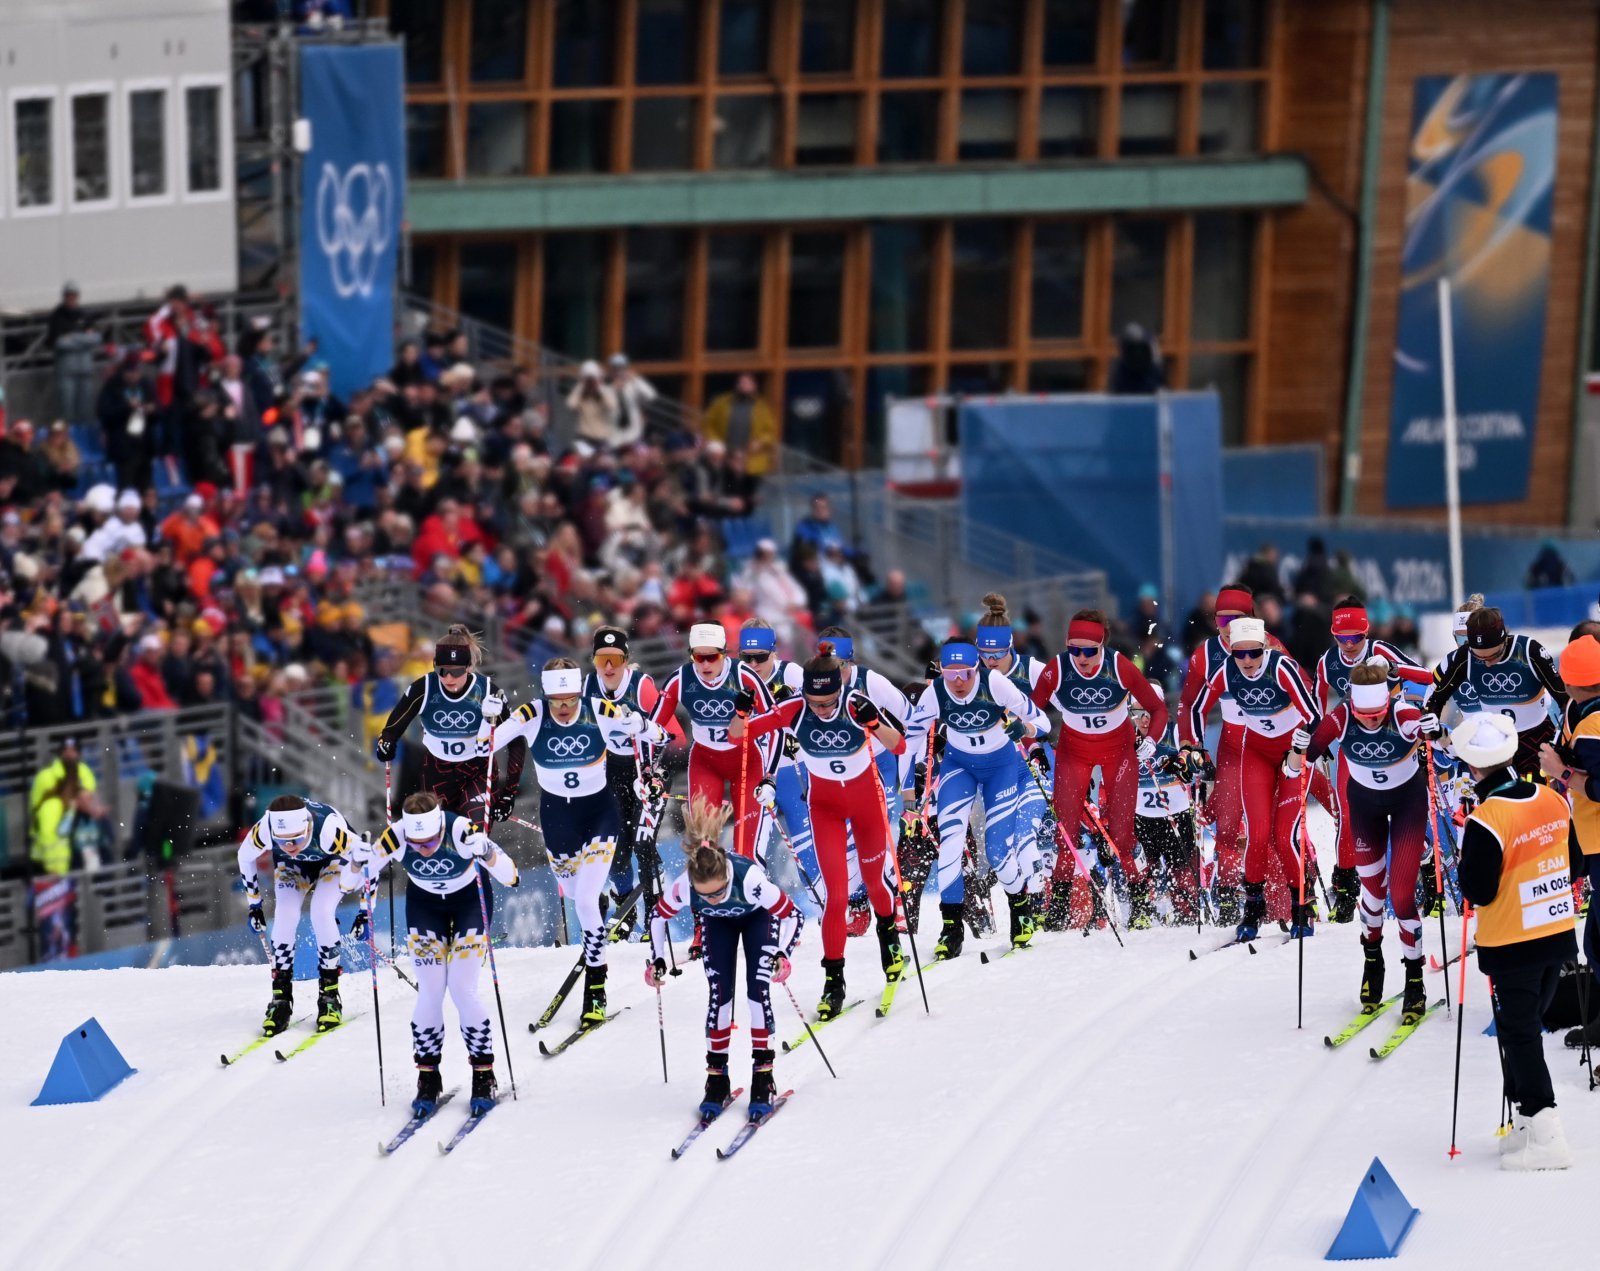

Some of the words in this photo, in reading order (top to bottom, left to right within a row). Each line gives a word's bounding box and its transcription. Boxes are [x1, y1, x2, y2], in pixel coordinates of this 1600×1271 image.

[1082, 715, 1107, 729] 16
[1259, 719, 1276, 731] 3
[708, 727, 728, 743] 12
[966, 734, 986, 747] 11
[441, 740, 466, 756] 10
[829, 760, 846, 774] 6
[563, 771, 580, 789] 8
[1371, 769, 1389, 784] 5
[994, 784, 1018, 801] SWIX
[1443, 781, 1455, 794] 26
[1142, 790, 1170, 809] 28
[1537, 855, 1566, 873] TEAM
[432, 881, 448, 890] 2
[1532, 883, 1549, 898] FIN
[1548, 901, 1569, 916] CCS
[455, 944, 481, 953] CRAFT
[414, 957, 442, 967] SWE
[756, 945, 779, 983] USA
